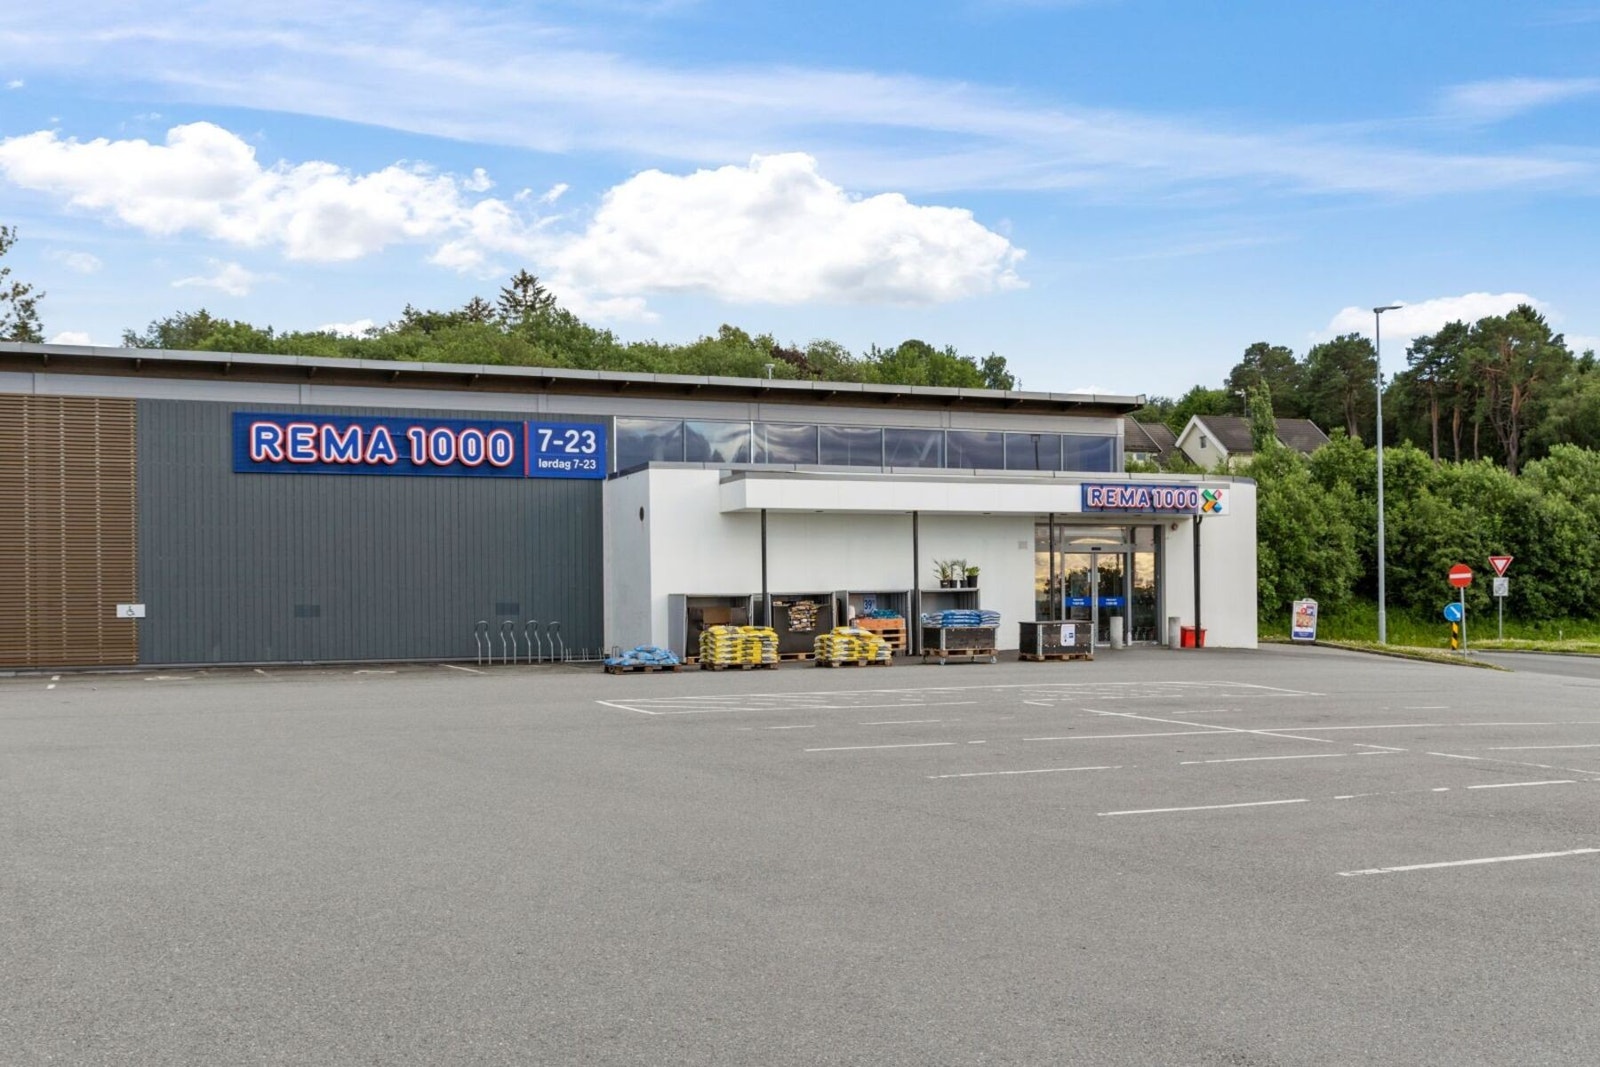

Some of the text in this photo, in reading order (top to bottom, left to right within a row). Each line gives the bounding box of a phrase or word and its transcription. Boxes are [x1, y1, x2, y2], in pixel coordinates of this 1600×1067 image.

[249, 421, 515, 468] REMA 1000
[538, 429, 596, 454] 7-23
[538, 458, 596, 470] lørdag 7-23
[1086, 486, 1198, 509] REMA 1000
